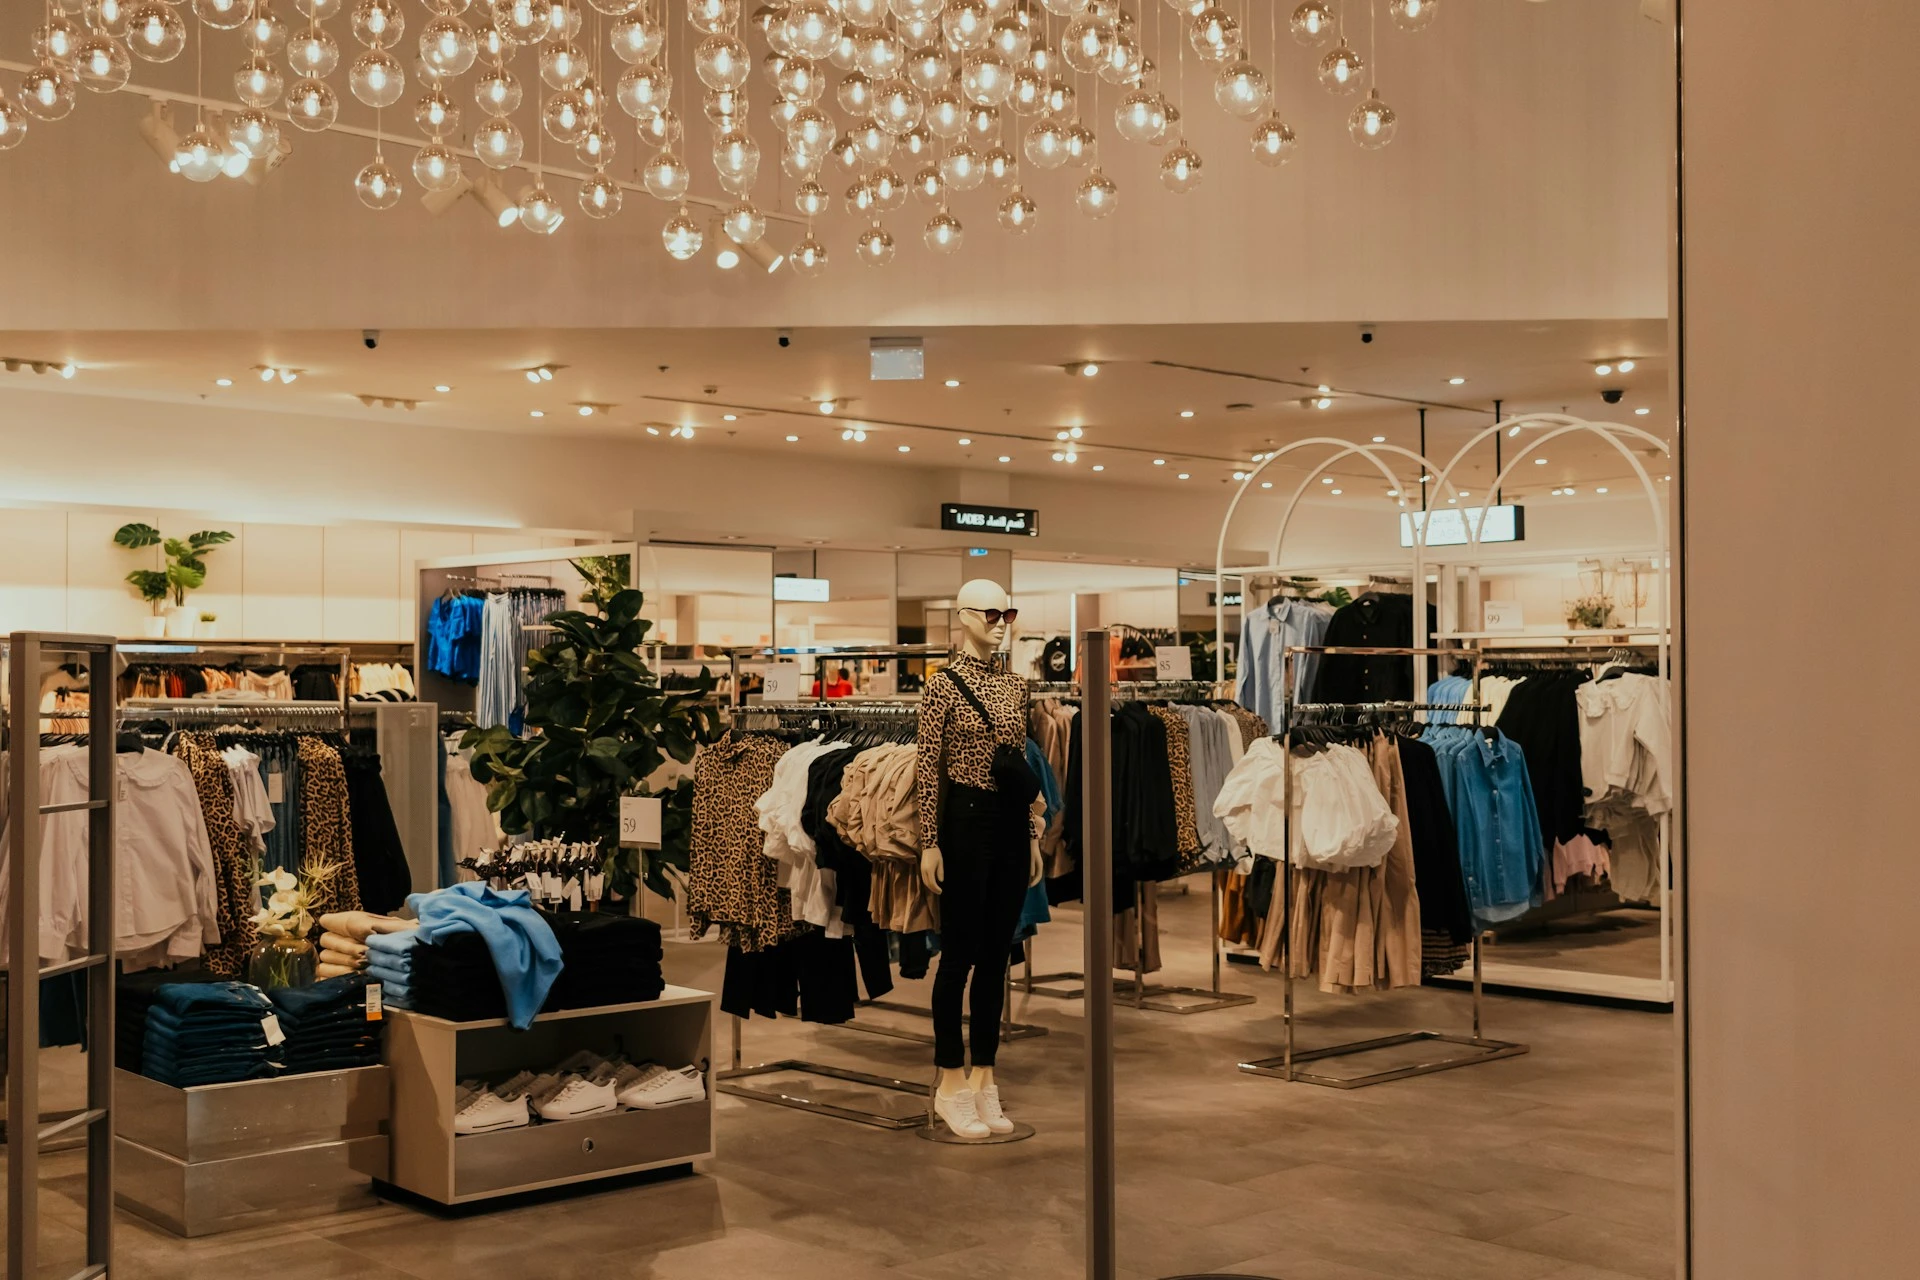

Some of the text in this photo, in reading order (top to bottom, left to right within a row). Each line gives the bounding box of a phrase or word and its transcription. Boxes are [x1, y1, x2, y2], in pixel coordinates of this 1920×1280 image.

[956, 513, 985, 526] LADIES
[1487, 614, 1500, 625] 99
[1159, 660, 1171, 672] 85
[766, 679, 778, 693] 59
[623, 817, 637, 833] 59
